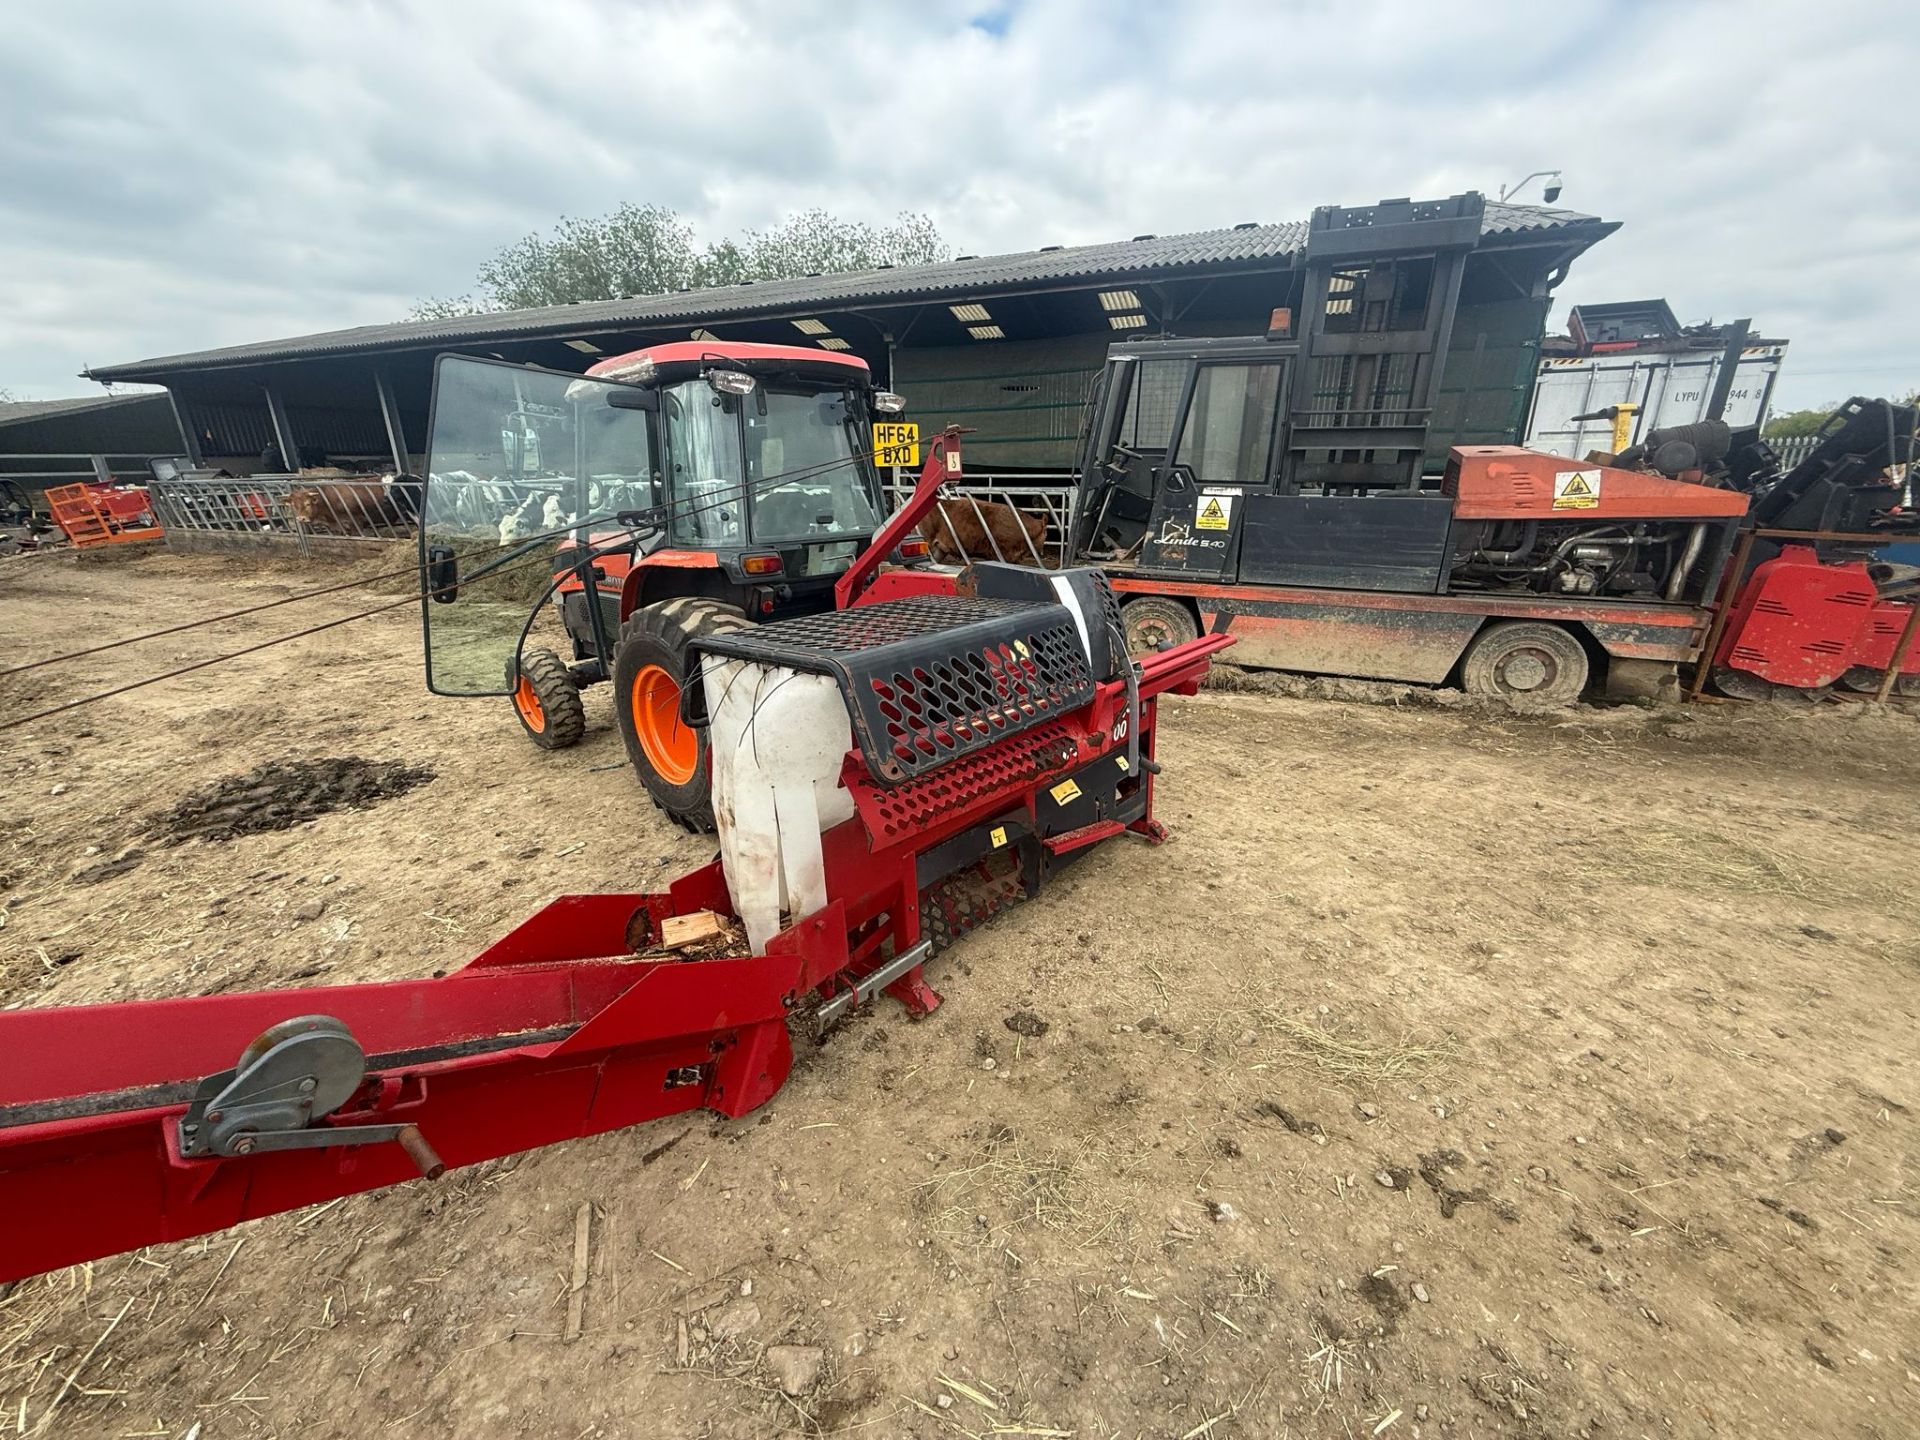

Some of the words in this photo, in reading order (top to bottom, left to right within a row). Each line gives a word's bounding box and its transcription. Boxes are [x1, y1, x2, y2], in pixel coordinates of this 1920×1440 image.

[1674, 391, 1700, 402] LYPU
[877, 426, 915, 443] HF64
[883, 446, 911, 464] BXD
[1153, 533, 1199, 546] Linde
